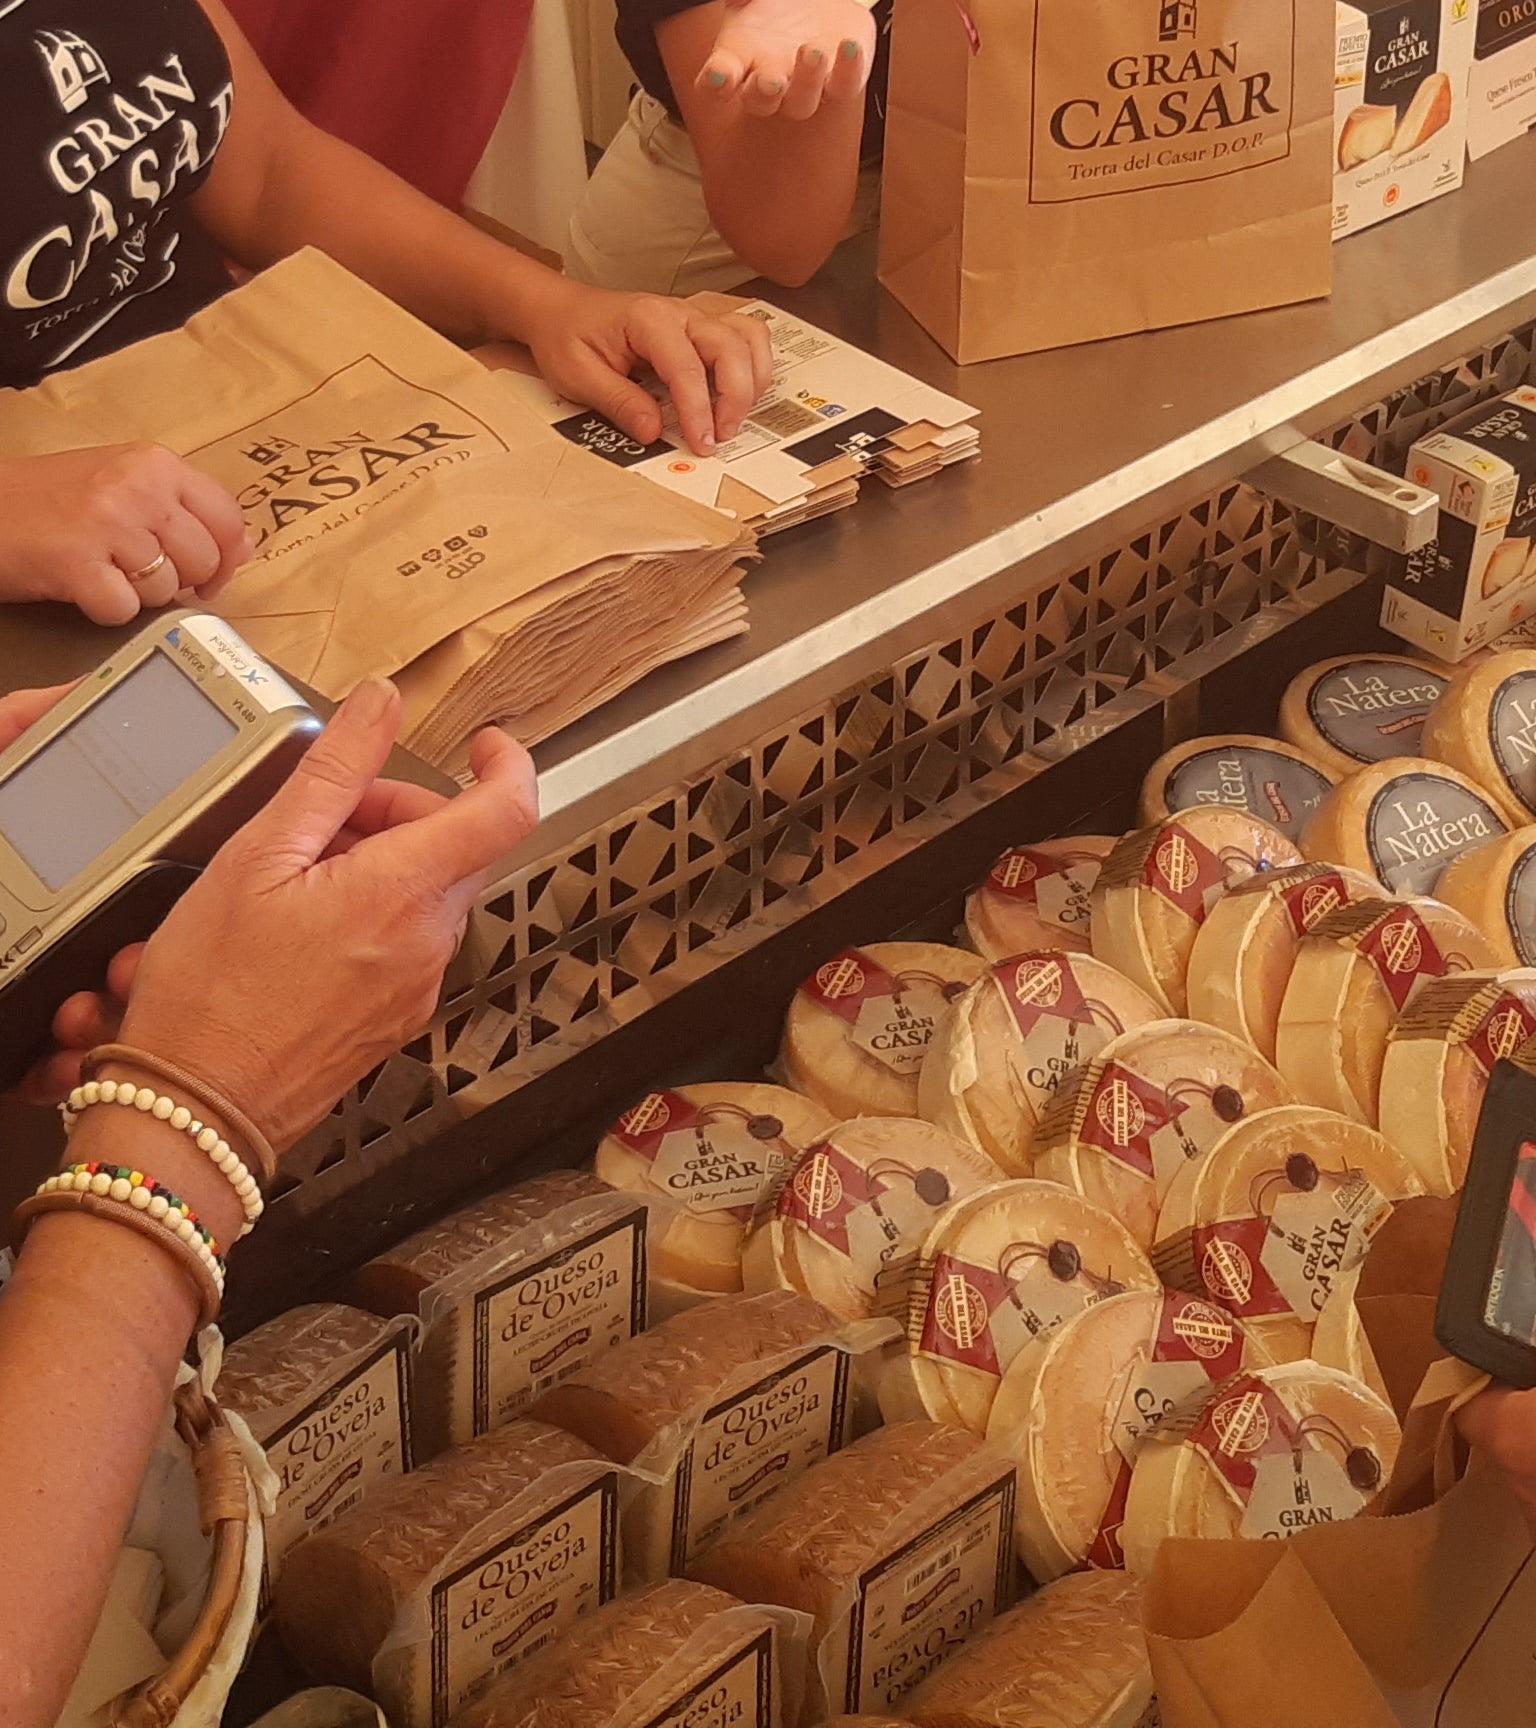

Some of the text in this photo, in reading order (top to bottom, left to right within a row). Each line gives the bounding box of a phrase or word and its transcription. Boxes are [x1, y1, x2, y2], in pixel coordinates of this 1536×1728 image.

[1498, 0, 1536, 28] ORO
[1374, 39, 1430, 74] CASAR
[1387, 30, 1421, 53] GRAN
[1107, 42, 1241, 91] GRAN
[48, 52, 197, 194] GRAN
[1049, 71, 1280, 152] CASAR
[1068, 160, 1118, 183] Torta
[1123, 152, 1152, 175] del
[1156, 145, 1207, 167] Casar
[581, 418, 646, 456] CASAR
[1463, 409, 1521, 441] CASAR
[235, 430, 375, 510] GRAN
[254, 421, 477, 549] ASAR
[1326, 683, 1440, 717] Natera
[1341, 675, 1389, 696] La
[1383, 810, 1491, 869] Natera
[1397, 798, 1440, 832] La
[870, 1028, 933, 1051] CASA
[884, 1016, 934, 1034] GRAN
[668, 1161, 764, 1190] CASAR
[683, 1152, 738, 1172] GRAN
[1301, 1225, 1329, 1282] GRAN
[1310, 1216, 1352, 1312] CASAR
[517, 1251, 604, 1307] Queso
[500, 1313, 533, 1342] de
[542, 1268, 620, 1320] Oveja
[287, 1382, 370, 1456] Queso
[313, 1396, 386, 1463] Oveja
[722, 1376, 808, 1435] Queso
[703, 1440, 737, 1471] de
[744, 1393, 821, 1447] Oveja
[1278, 1505, 1334, 1528] GRAN
[477, 1521, 572, 1592] Queso
[460, 1535, 587, 1631] de Oveja
[681, 1686, 729, 1728] eso
